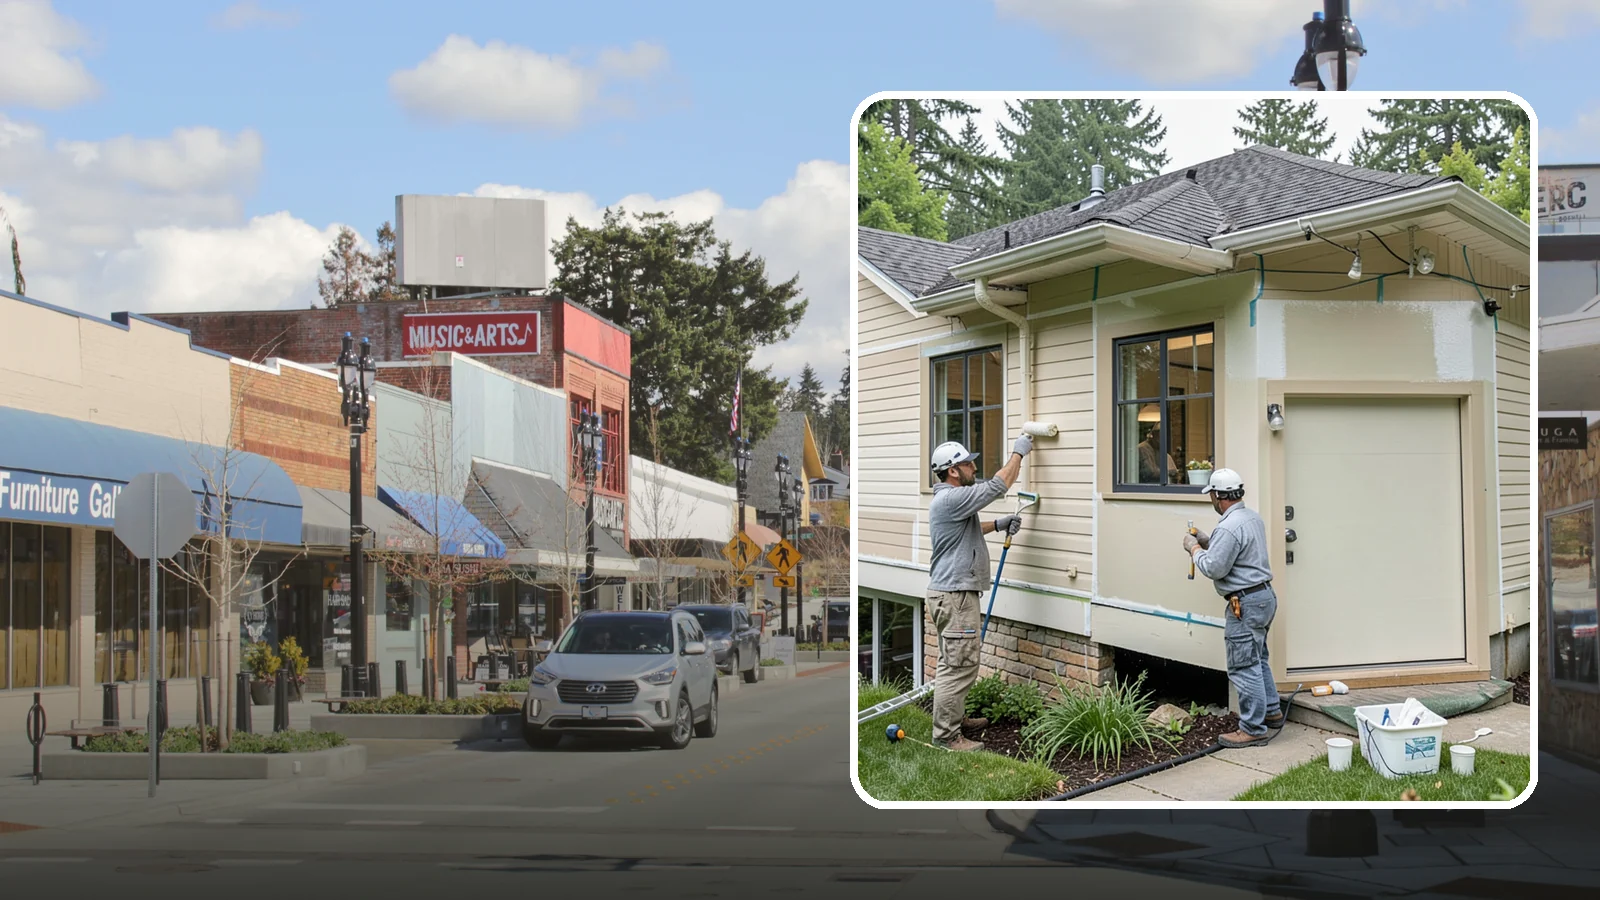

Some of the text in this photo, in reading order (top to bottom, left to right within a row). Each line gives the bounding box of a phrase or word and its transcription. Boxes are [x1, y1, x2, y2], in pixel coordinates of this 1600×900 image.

[1538, 182, 1586, 213] ERC
[1540, 427, 1577, 437] UGA
[0, 471, 79, 516] Furniture
